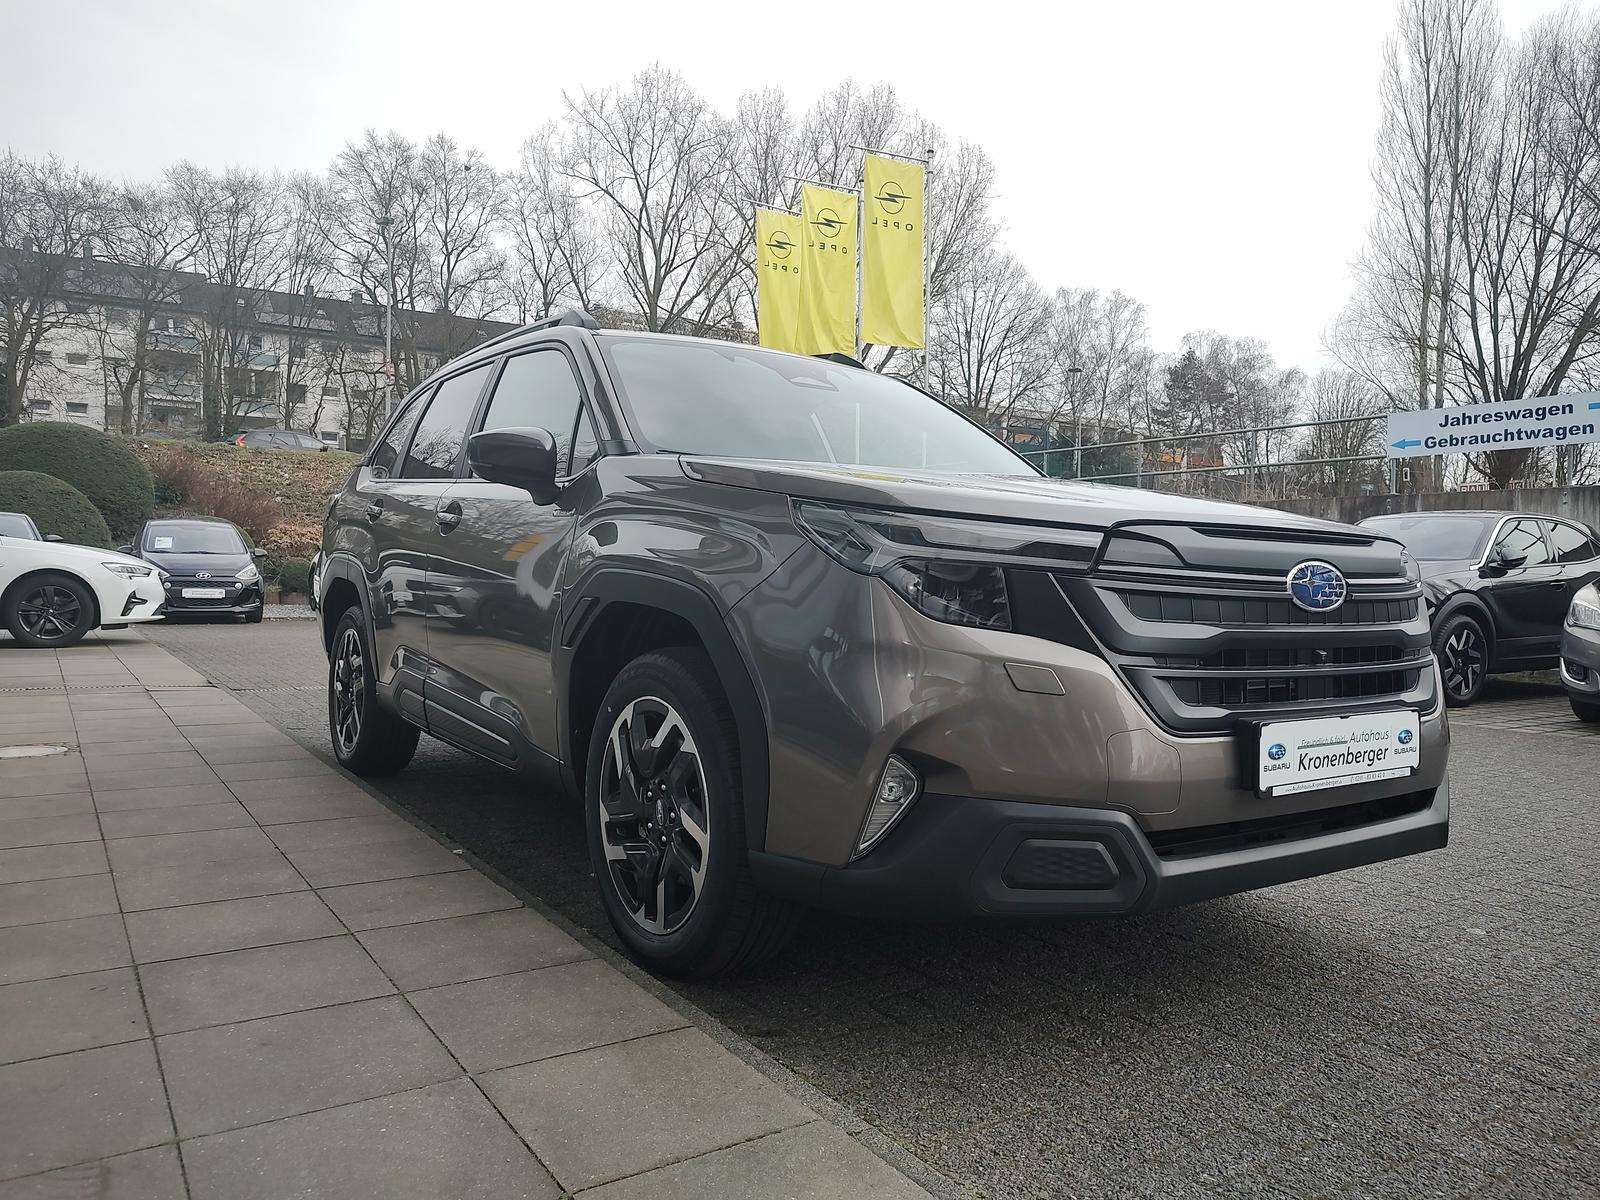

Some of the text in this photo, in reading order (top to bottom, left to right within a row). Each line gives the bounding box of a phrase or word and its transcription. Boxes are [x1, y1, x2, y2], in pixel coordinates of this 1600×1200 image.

[1438, 403, 1574, 428] Jahreswagen
[1424, 423, 1595, 450] Gebrauchtwagen
[1349, 729, 1389, 744] Autohaus
[1297, 746, 1389, 772] Kronenberger
[1393, 746, 1417, 755] SUBARU
[1263, 762, 1291, 773] SUBARU
